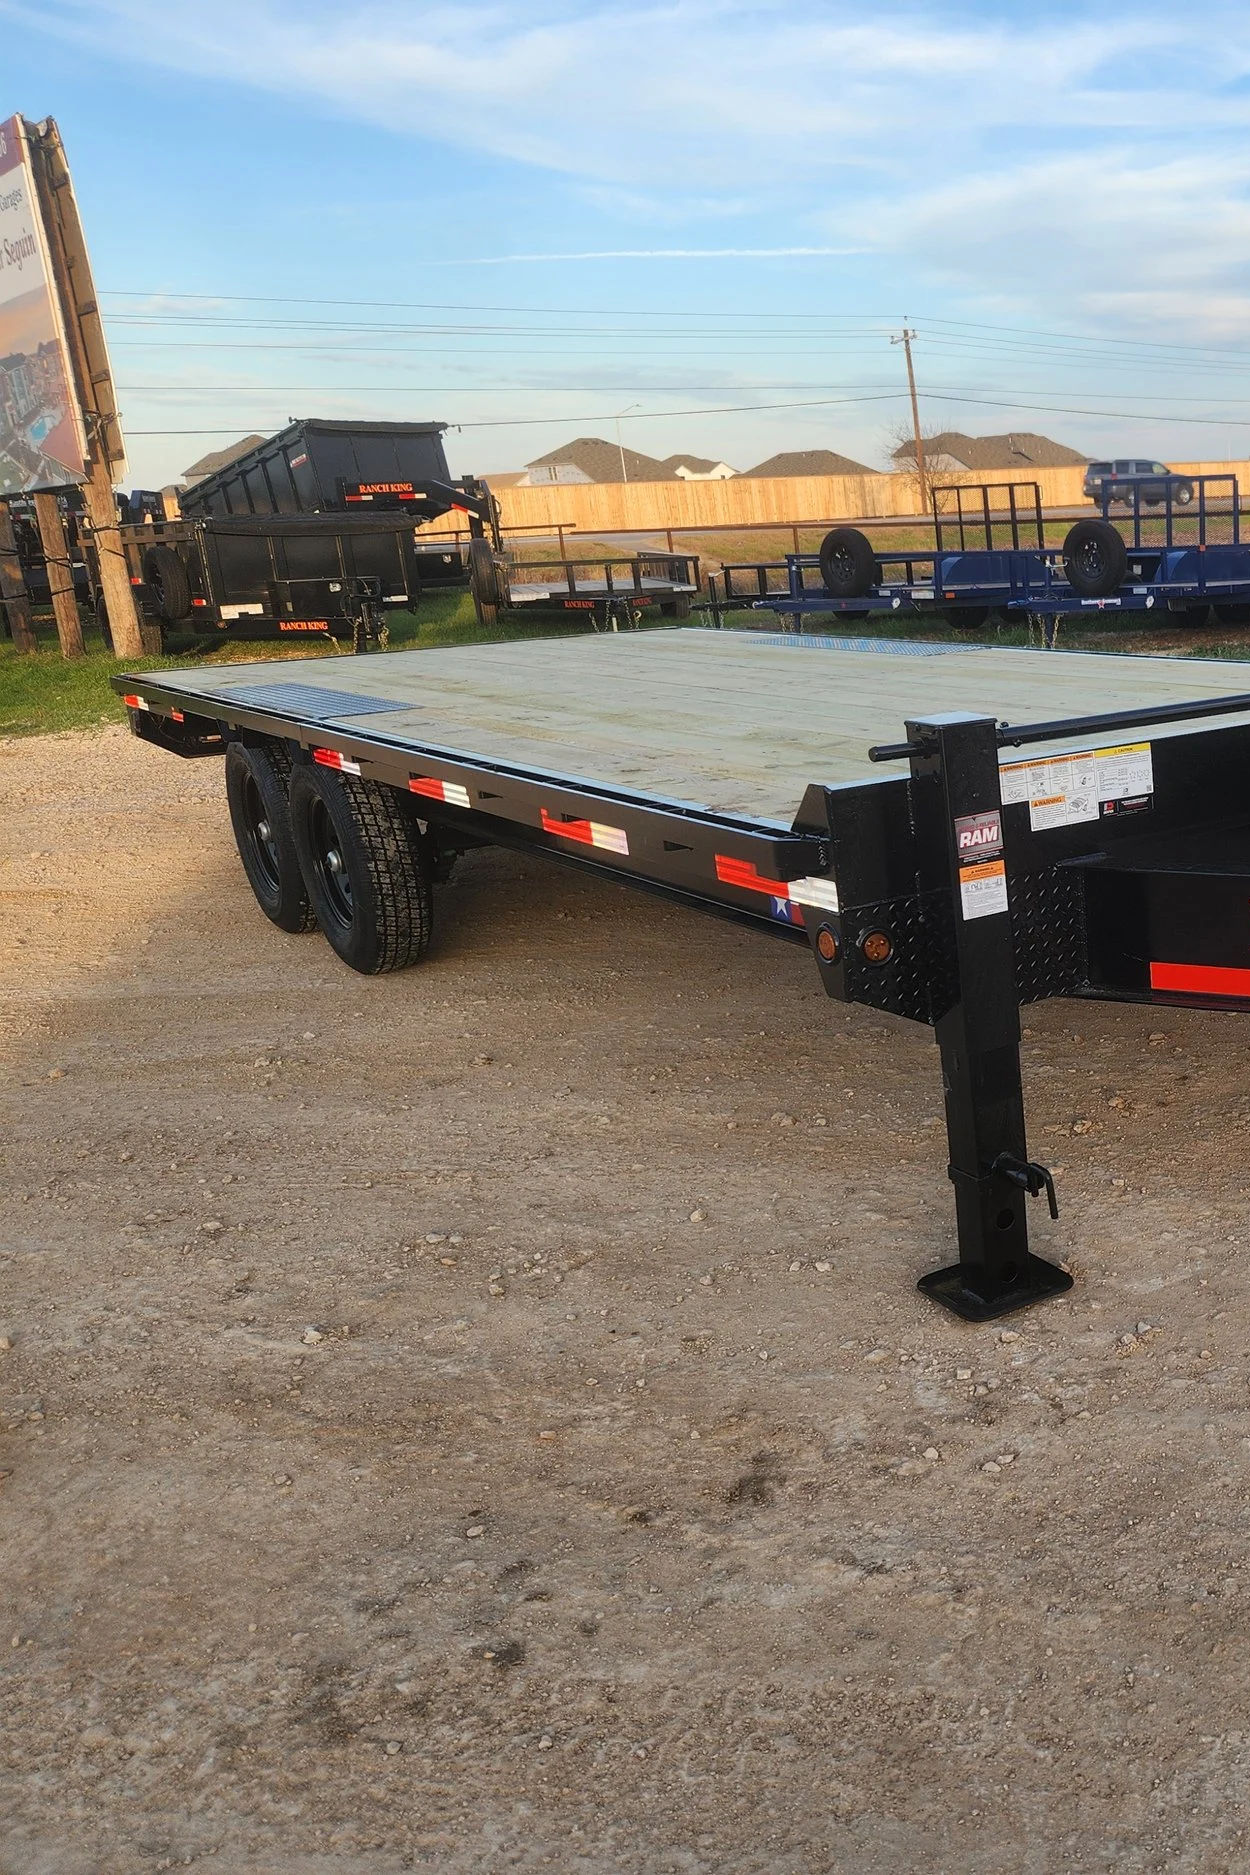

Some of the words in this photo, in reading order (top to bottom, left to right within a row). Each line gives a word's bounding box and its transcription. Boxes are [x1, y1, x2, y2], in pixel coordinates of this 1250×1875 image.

[4, 227, 37, 271] Seguin
[359, 484, 389, 493] RANCH
[390, 483, 413, 492] KING
[280, 622, 307, 630] RANCH
[308, 621, 328, 630] KING
[960, 825, 998, 848] RAM
